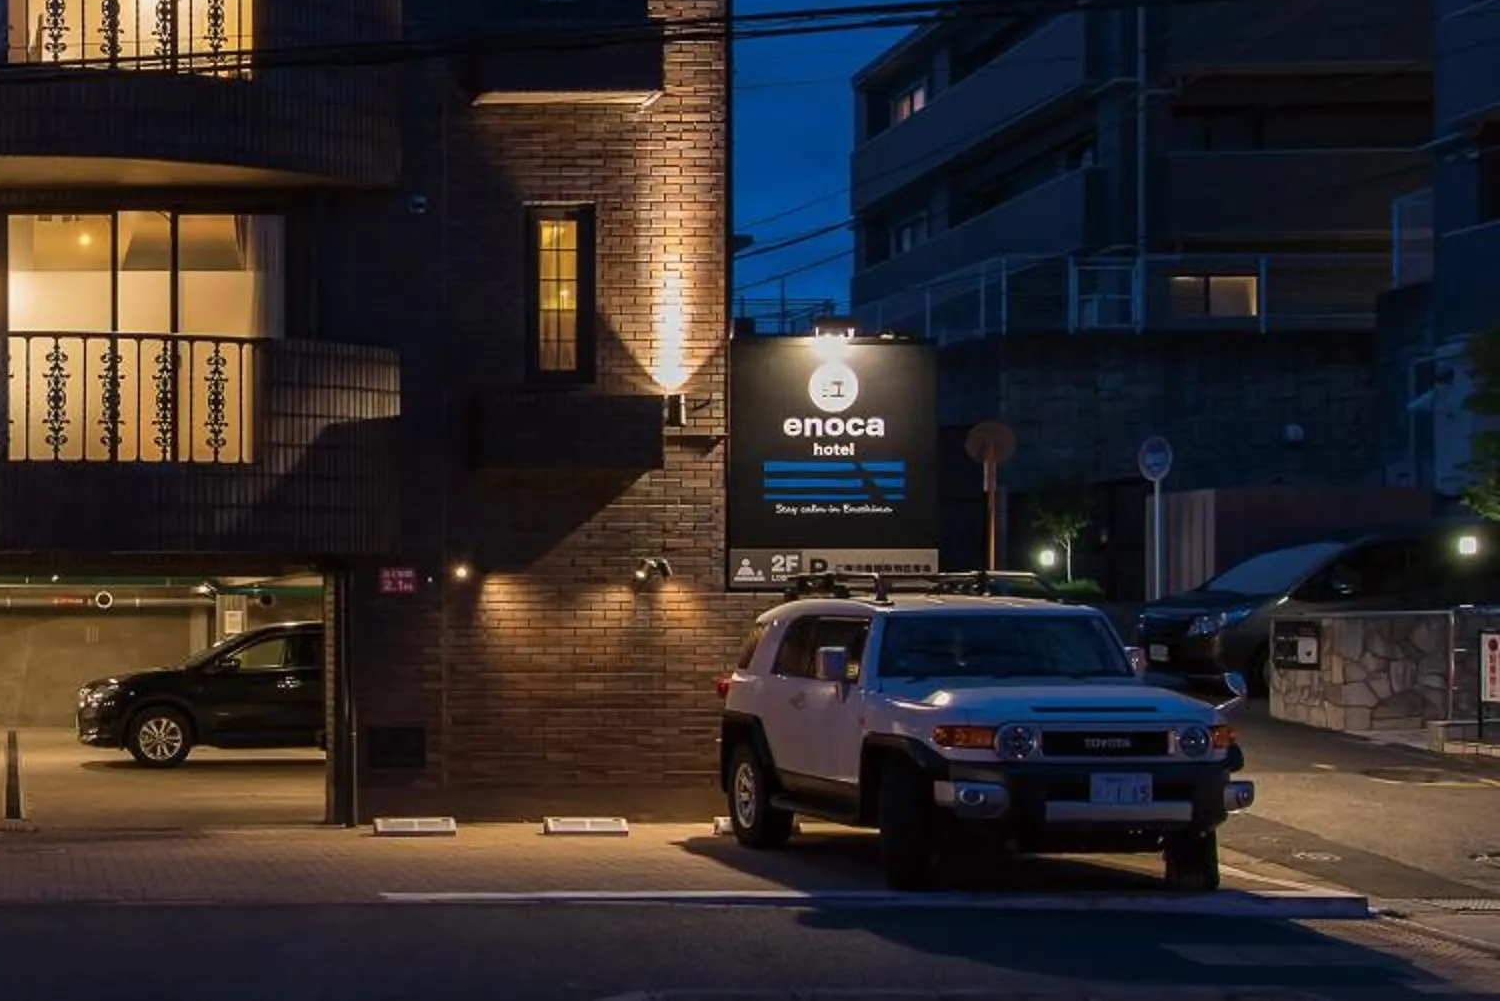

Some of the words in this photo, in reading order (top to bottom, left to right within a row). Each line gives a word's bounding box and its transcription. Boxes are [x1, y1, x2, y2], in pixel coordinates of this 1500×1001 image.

[783, 417, 885, 437] enoca
[813, 442, 855, 456] hotel
[771, 554, 799, 572] 2F
